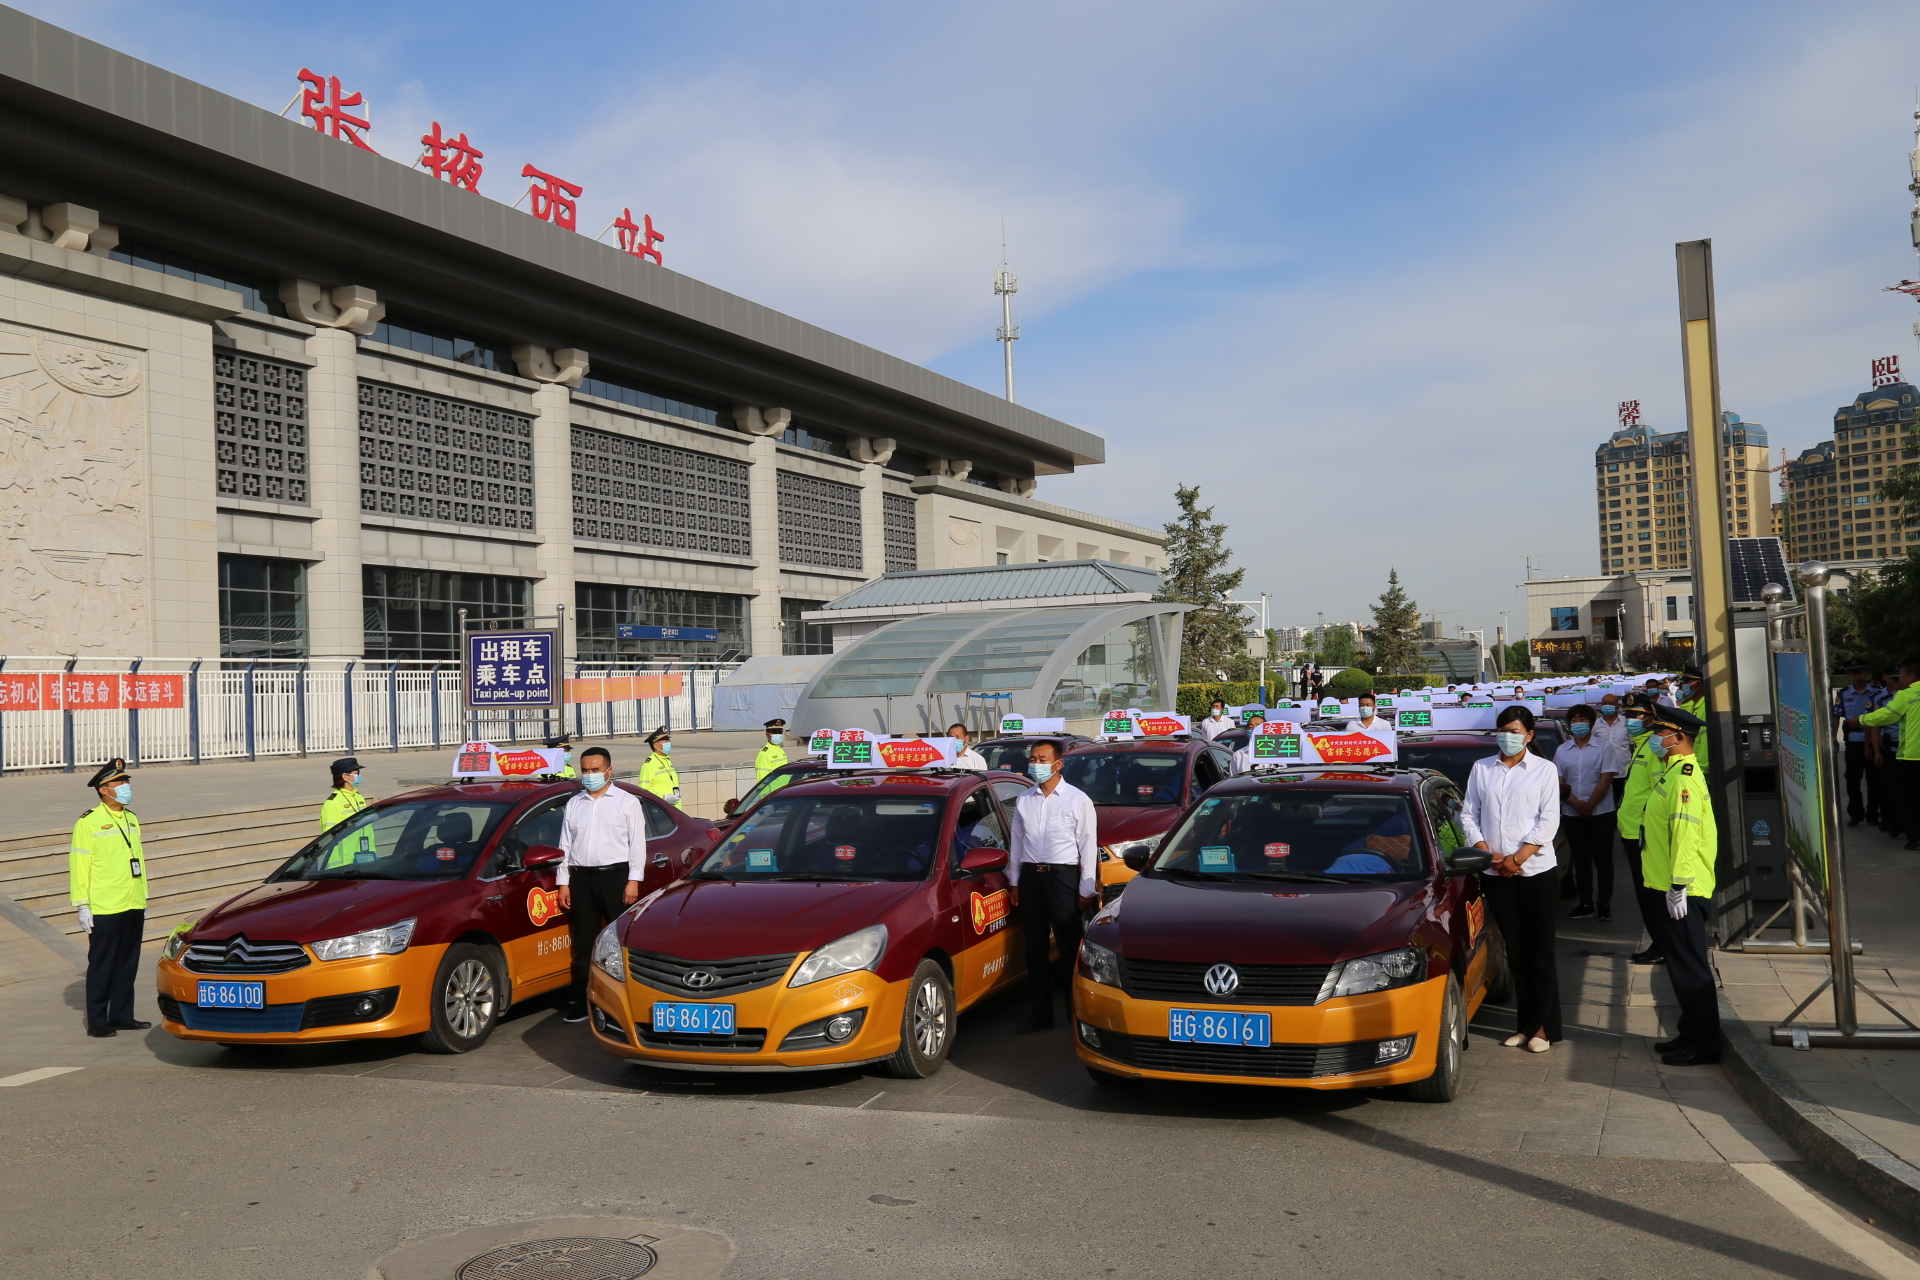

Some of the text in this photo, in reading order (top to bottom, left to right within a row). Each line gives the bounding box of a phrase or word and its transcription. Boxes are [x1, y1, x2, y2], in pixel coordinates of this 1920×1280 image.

[297, 68, 664, 266] 张掖西站
[1872, 355, 1900, 386] 熙
[1618, 400, 1640, 426] 馨
[480, 639, 542, 661] 出租车
[1533, 640, 1584, 653] 平价超市
[476, 663, 546, 686] 乘车点
[51, 680, 110, 704] 牢记使命
[118, 680, 175, 703] 永远奋斗
[474, 688, 492, 698] Taxi
[493, 688, 525, 700] pick-up
[527, 687, 549, 700] point
[1321, 705, 1340, 715] 空车
[1003, 720, 1022, 730] 空车
[1104, 720, 1132, 732] 空车
[1400, 712, 1430, 726] 空车
[840, 731, 863, 741] 安吉
[1263, 723, 1291, 734] 安吉
[466, 743, 487, 752] 安吉
[835, 743, 870, 762] 空车
[1255, 736, 1298, 757] 空车
[1326, 747, 1381, 757] 雷锋号志愿车
[460, 754, 490, 771] 有客
[200, 986, 261, 1004] 甘G·86100
[838, 988, 857, 998] LPG
[656, 1008, 732, 1029] 甘G·86120
[1172, 1014, 1264, 1041] 甘G·86161
